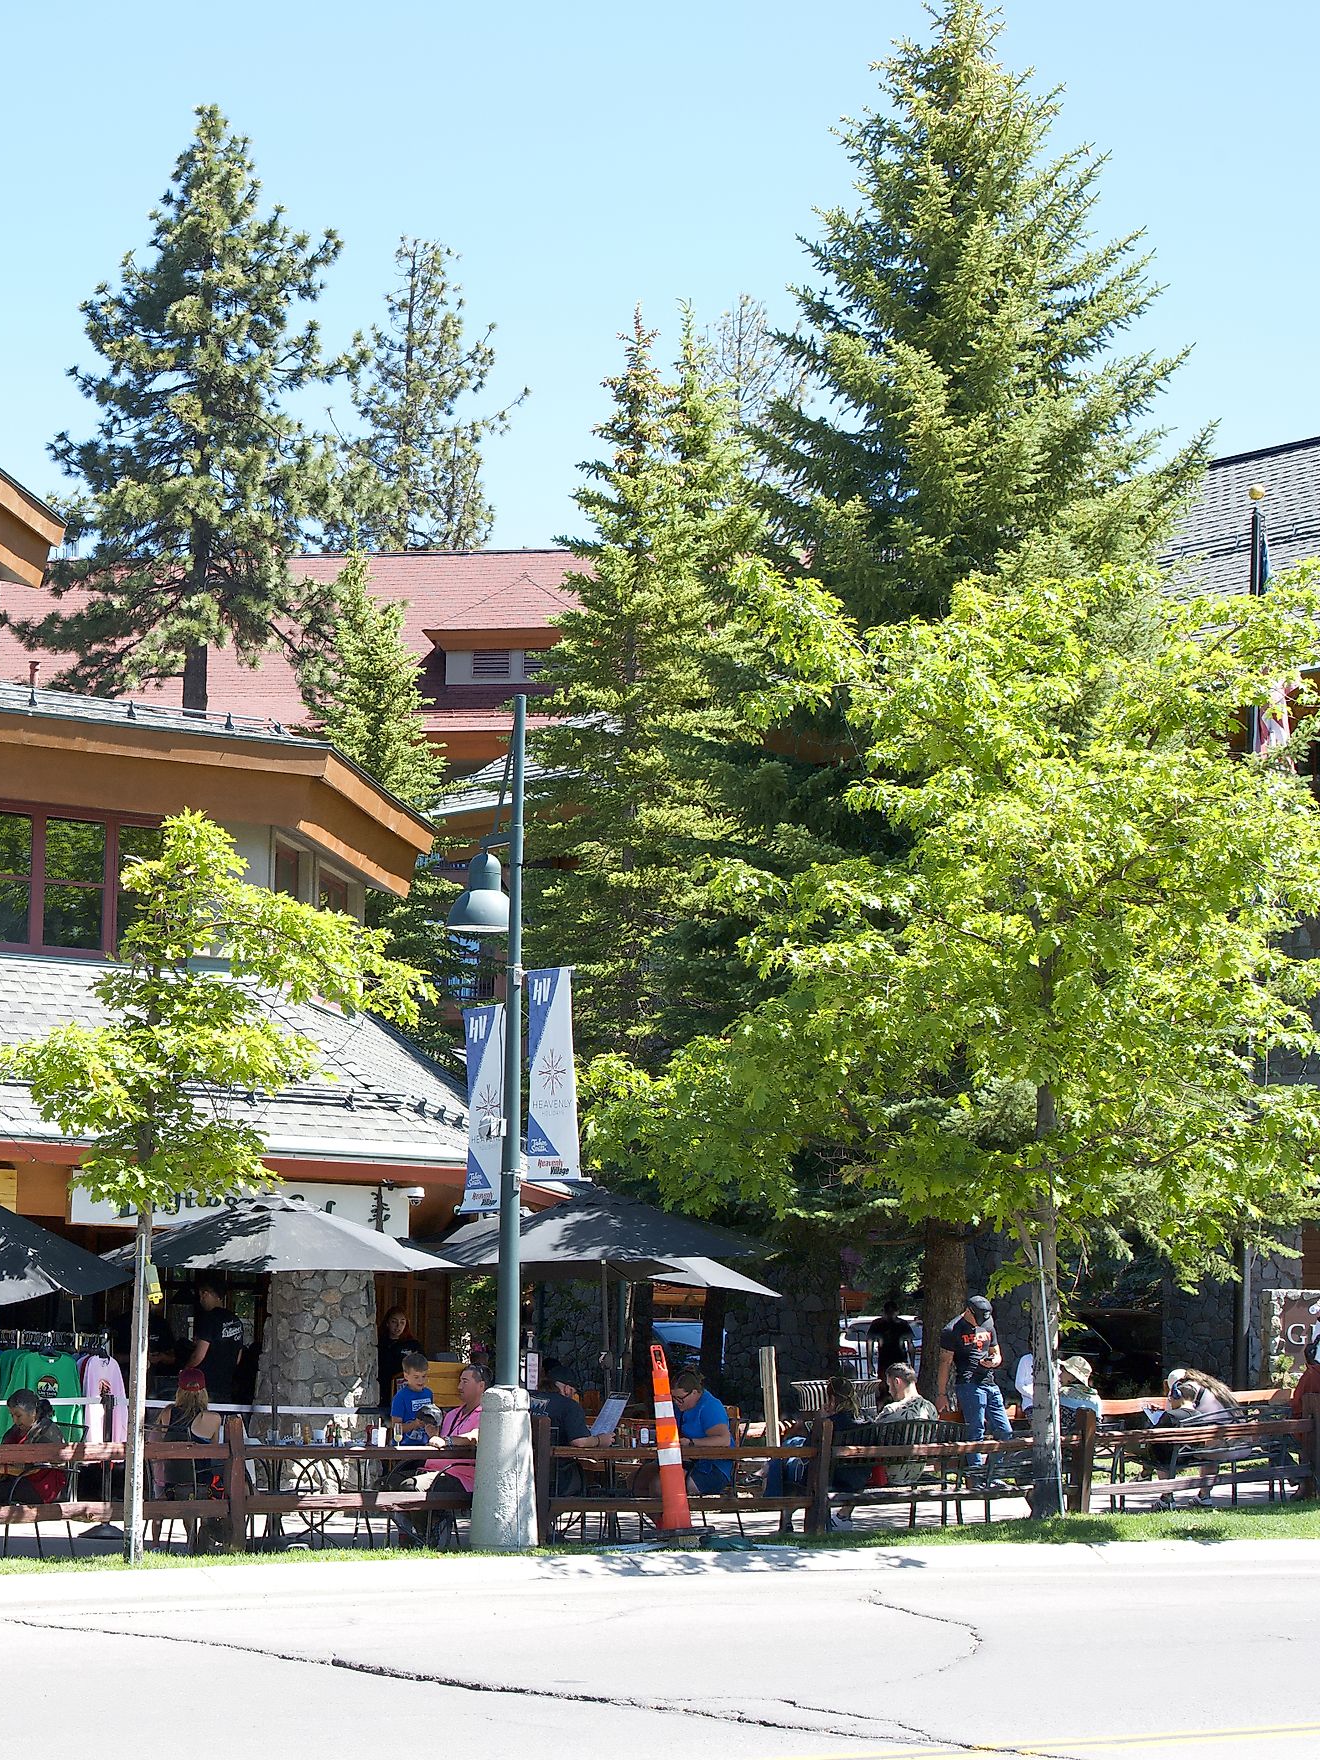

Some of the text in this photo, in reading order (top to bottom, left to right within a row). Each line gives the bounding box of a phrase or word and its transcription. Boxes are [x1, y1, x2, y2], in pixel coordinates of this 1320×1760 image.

[532, 977, 551, 1006] HV
[468, 1014, 488, 1044] HV
[532, 1099, 572, 1109] HEAVENLY
[537, 1158, 564, 1169] Heavenly
[549, 1166, 570, 1177] Village
